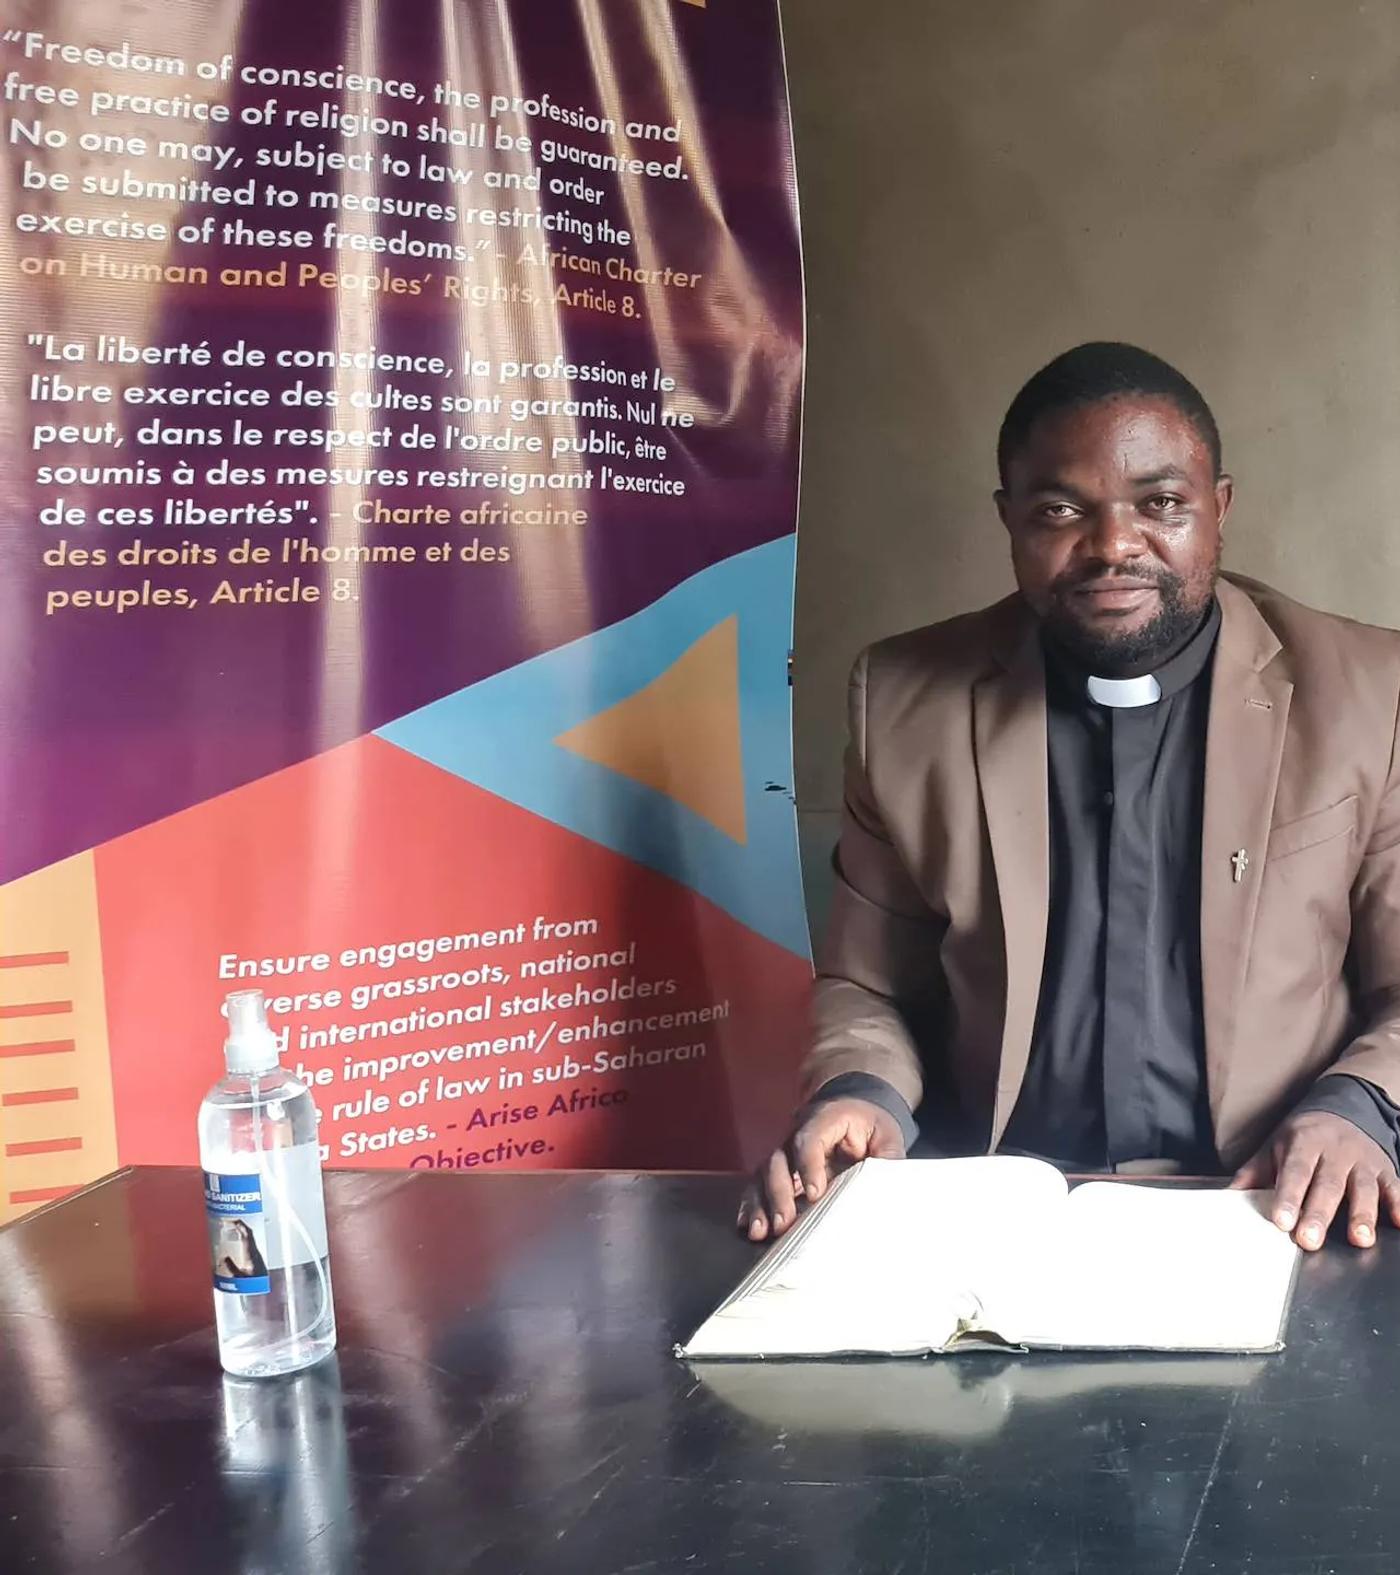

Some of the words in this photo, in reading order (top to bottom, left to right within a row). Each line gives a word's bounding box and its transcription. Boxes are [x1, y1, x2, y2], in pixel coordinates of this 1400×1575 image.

[3, 71, 80, 107] free
[90, 93, 231, 123] practice
[286, 102, 408, 138] religion
[416, 116, 486, 148] shall
[540, 138, 689, 181] guaranteed.
[240, 64, 426, 106] conscience,
[434, 82, 481, 108] the
[490, 93, 616, 136] profession
[625, 119, 682, 143] and
[79, 132, 147, 157] one
[158, 138, 244, 171] may,
[255, 141, 374, 176] subject
[419, 154, 473, 185] law
[483, 166, 542, 192] and
[549, 176, 605, 206] order
[81, 169, 257, 206] submitted
[309, 190, 457, 222] measures
[465, 204, 594, 242] restricting
[596, 219, 632, 246] the
[15, 211, 168, 241] exercise
[222, 218, 314, 248] these
[517, 243, 602, 275] African
[605, 257, 702, 289] Charter
[80, 252, 208, 286] Human
[219, 261, 287, 288] and
[443, 274, 540, 306] Rights,
[553, 283, 617, 316] Article
[622, 298, 642, 319] 8.
[97, 336, 211, 367] liberté
[276, 346, 453, 378] conscience,
[500, 355, 627, 388] profession
[30, 374, 112, 403] libre
[123, 381, 270, 407] exercice
[281, 380, 340, 408] des
[350, 384, 433, 412] cultes
[441, 393, 502, 415] sont
[510, 398, 623, 422] garantis.
[33, 422, 125, 450] peut,
[136, 418, 224, 446] dans
[273, 425, 393, 452] respect
[445, 424, 543, 453] l'ordre
[551, 430, 631, 459] public,
[634, 437, 667, 461] être
[36, 460, 162, 485] soumis
[205, 458, 266, 486] des
[276, 466, 409, 487] mesures
[417, 465, 594, 495] restreignant
[600, 466, 686, 497] l'exercice
[97, 505, 154, 526] ces
[352, 499, 451, 525] Charte
[459, 501, 588, 527] africaine
[43, 539, 107, 567] des
[117, 538, 218, 566] droits
[281, 537, 416, 563] l'homme
[459, 538, 511, 563] des
[46, 579, 199, 615] peuples,
[210, 577, 321, 605] Article
[331, 578, 360, 602] 8.
[218, 953, 330, 979] Ensure
[340, 923, 525, 968] engagement
[532, 916, 598, 941] from
[220, 988, 341, 1019] erse
[350, 964, 511, 1010] grassroots,
[520, 942, 636, 979] national
[299, 996, 491, 1050] international
[500, 978, 677, 1017] stakeholders
[343, 999, 730, 1082] improvement/enhancement
[332, 1089, 390, 1121] rule
[436, 1076, 492, 1101] law
[532, 1042, 706, 1084] sub-Saharan
[339, 1123, 437, 1157] States.
[466, 1103, 539, 1131] Arise
